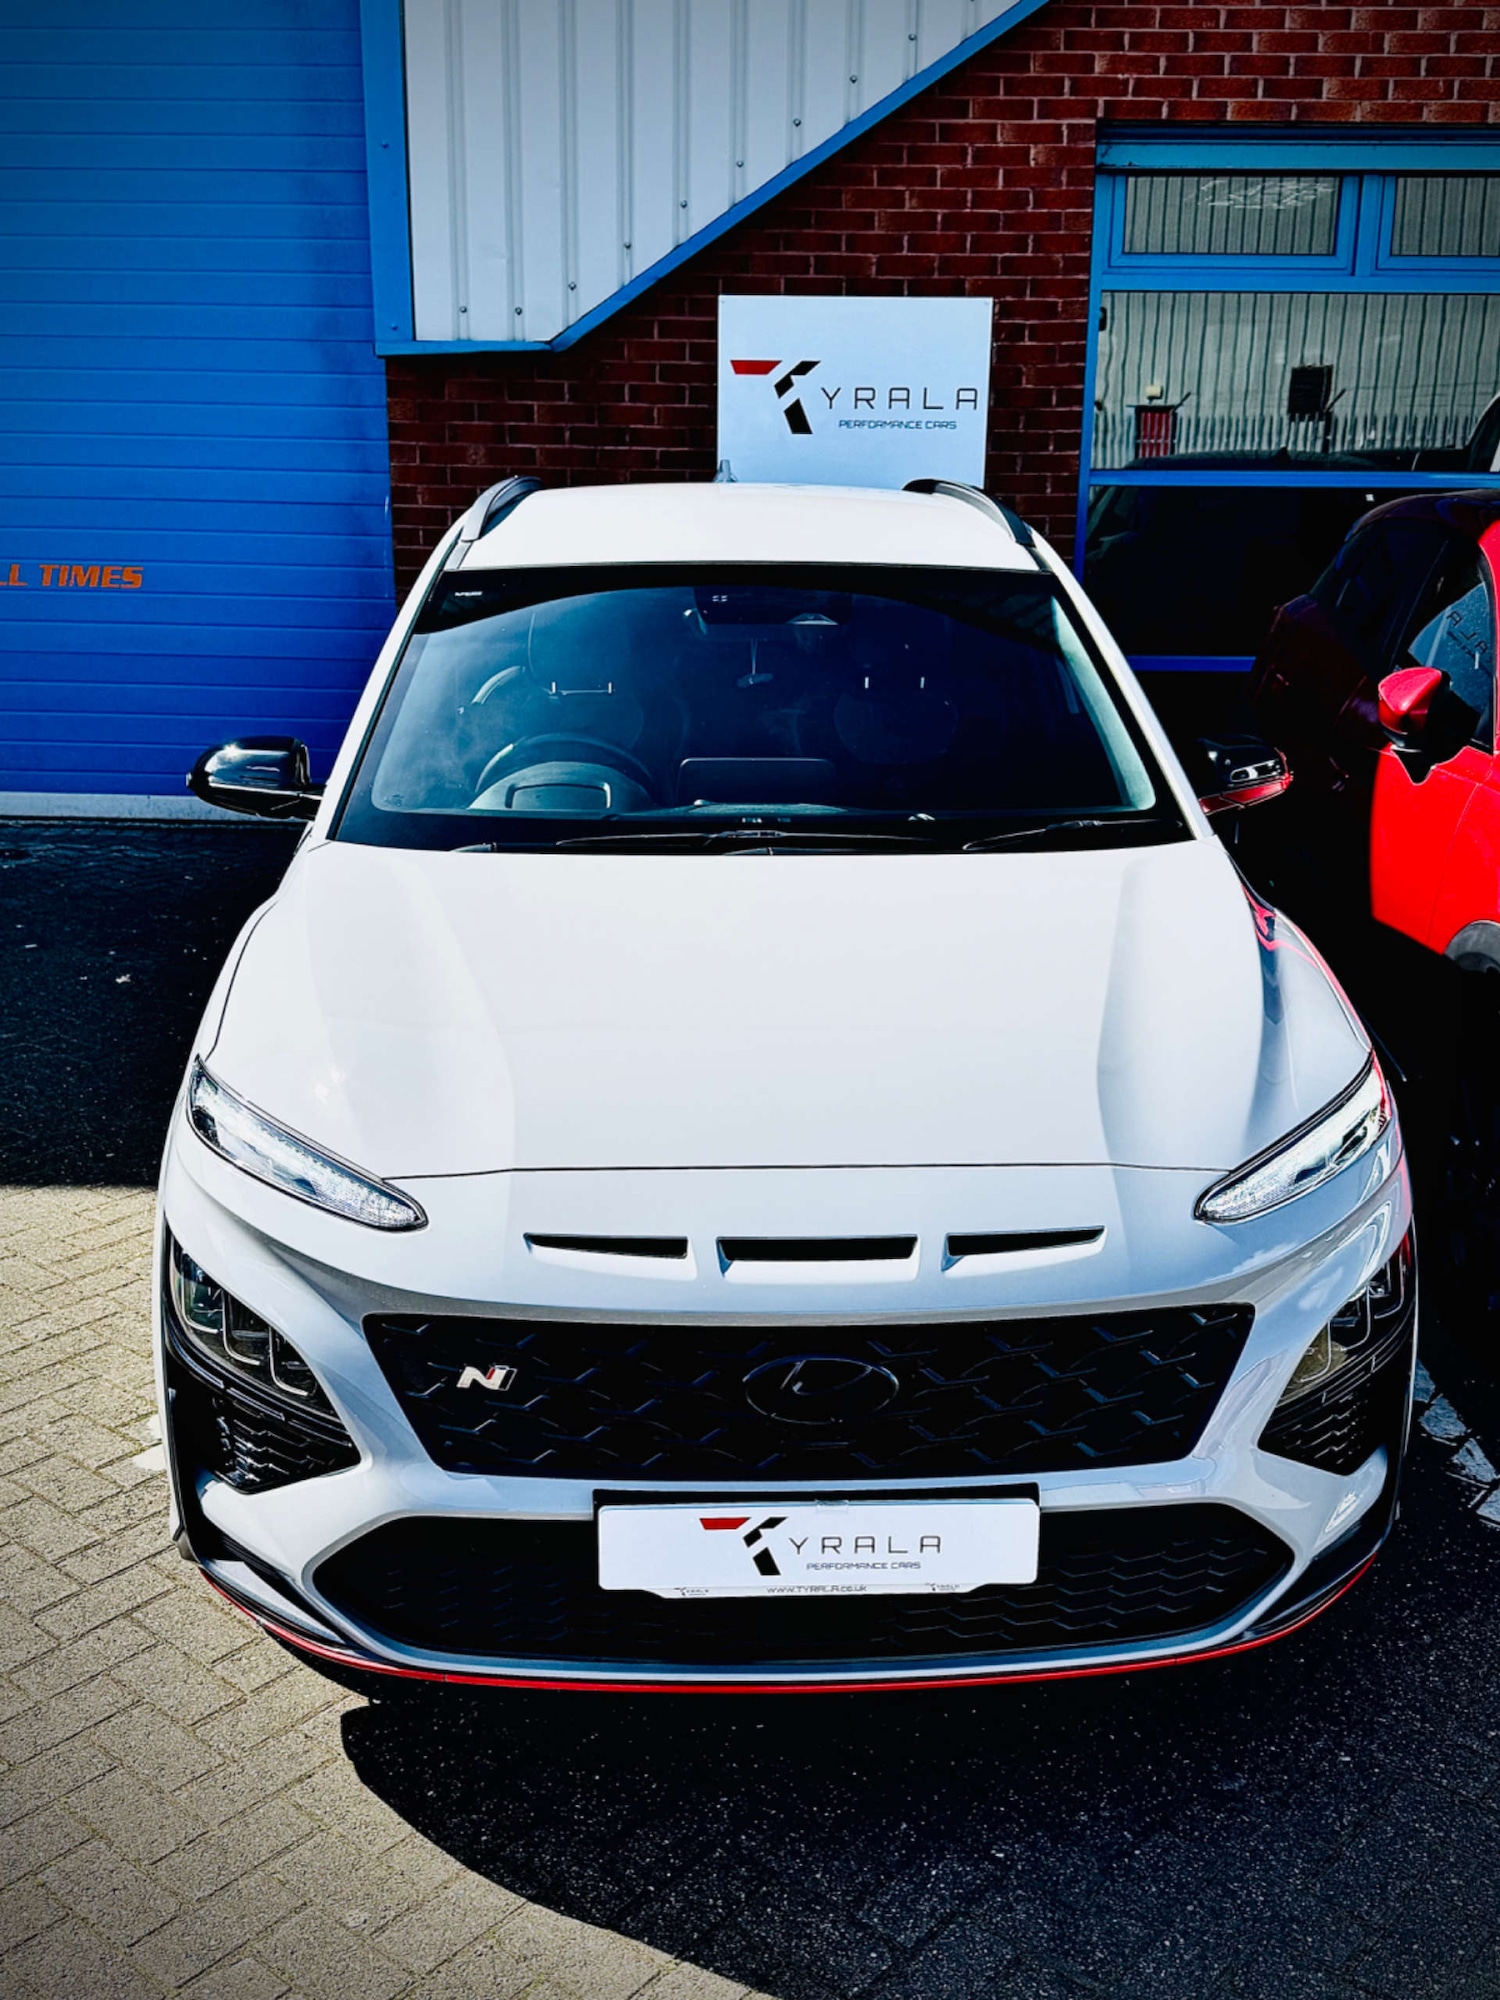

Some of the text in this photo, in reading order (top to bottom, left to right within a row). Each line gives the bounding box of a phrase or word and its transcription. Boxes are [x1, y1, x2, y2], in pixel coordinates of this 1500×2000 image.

[838, 420, 957, 430] PERFORMANCE CARS
[0, 563, 144, 588] L TIMES
[806, 1561, 921, 1571] PERFORMANCE CARS
